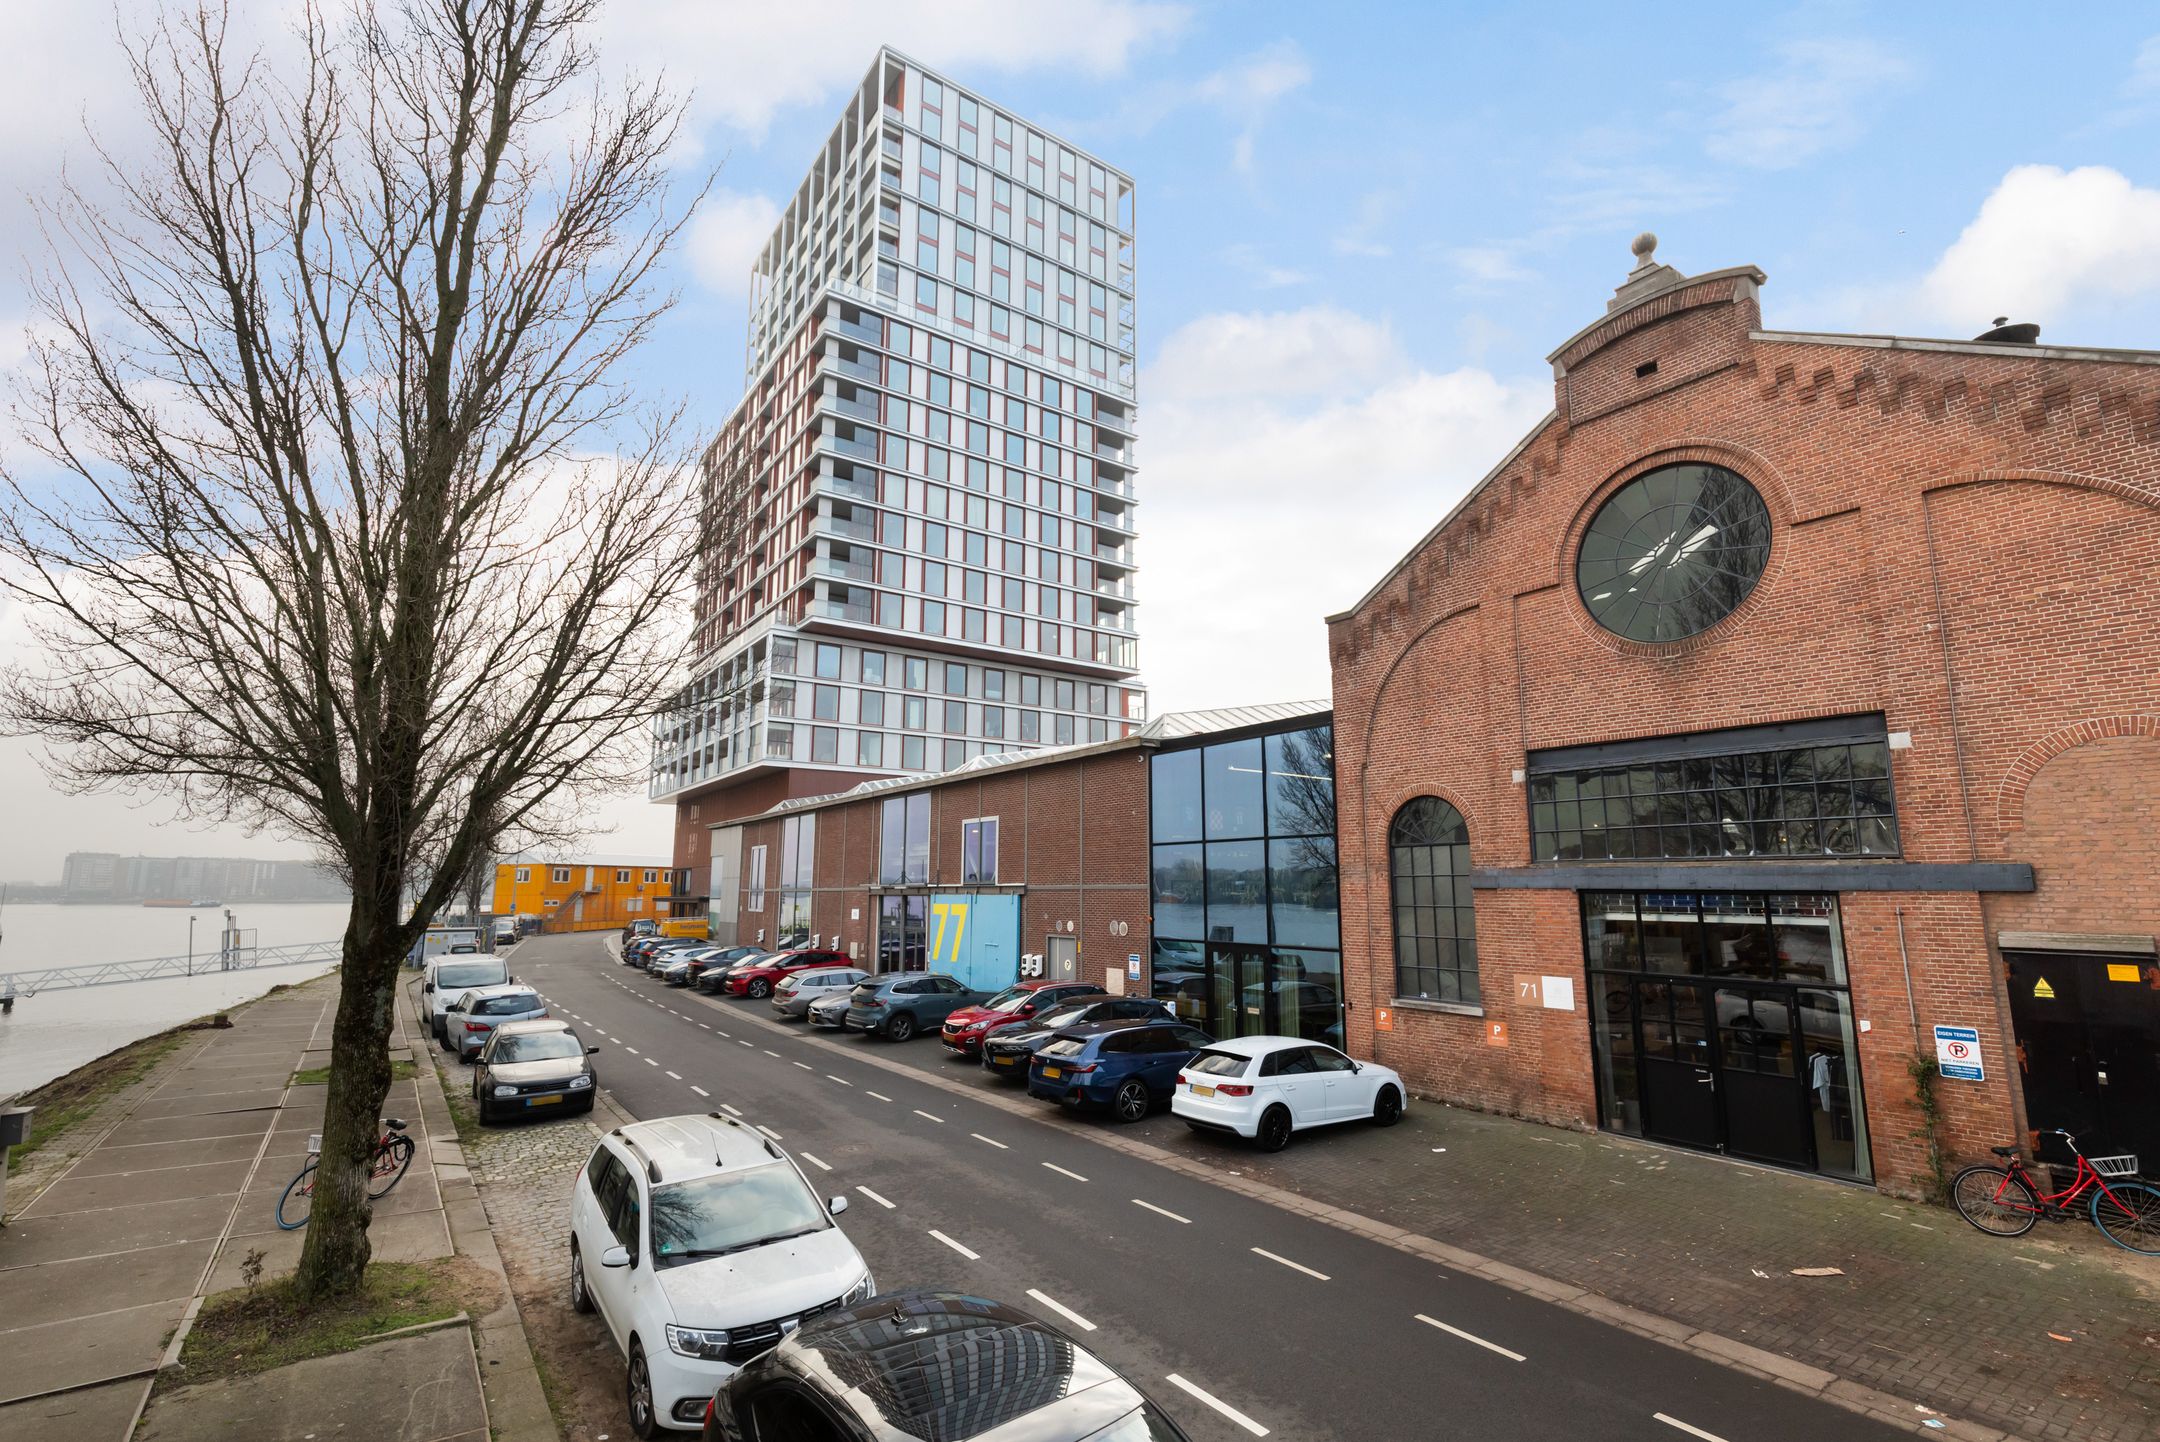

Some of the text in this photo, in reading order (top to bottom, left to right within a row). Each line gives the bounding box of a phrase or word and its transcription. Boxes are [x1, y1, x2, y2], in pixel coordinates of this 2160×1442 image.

[932, 903, 968, 962] 77
[1520, 983, 1536, 998] 71
[1380, 1011, 1387, 1021] P
[1493, 1025, 1501, 1035] P
